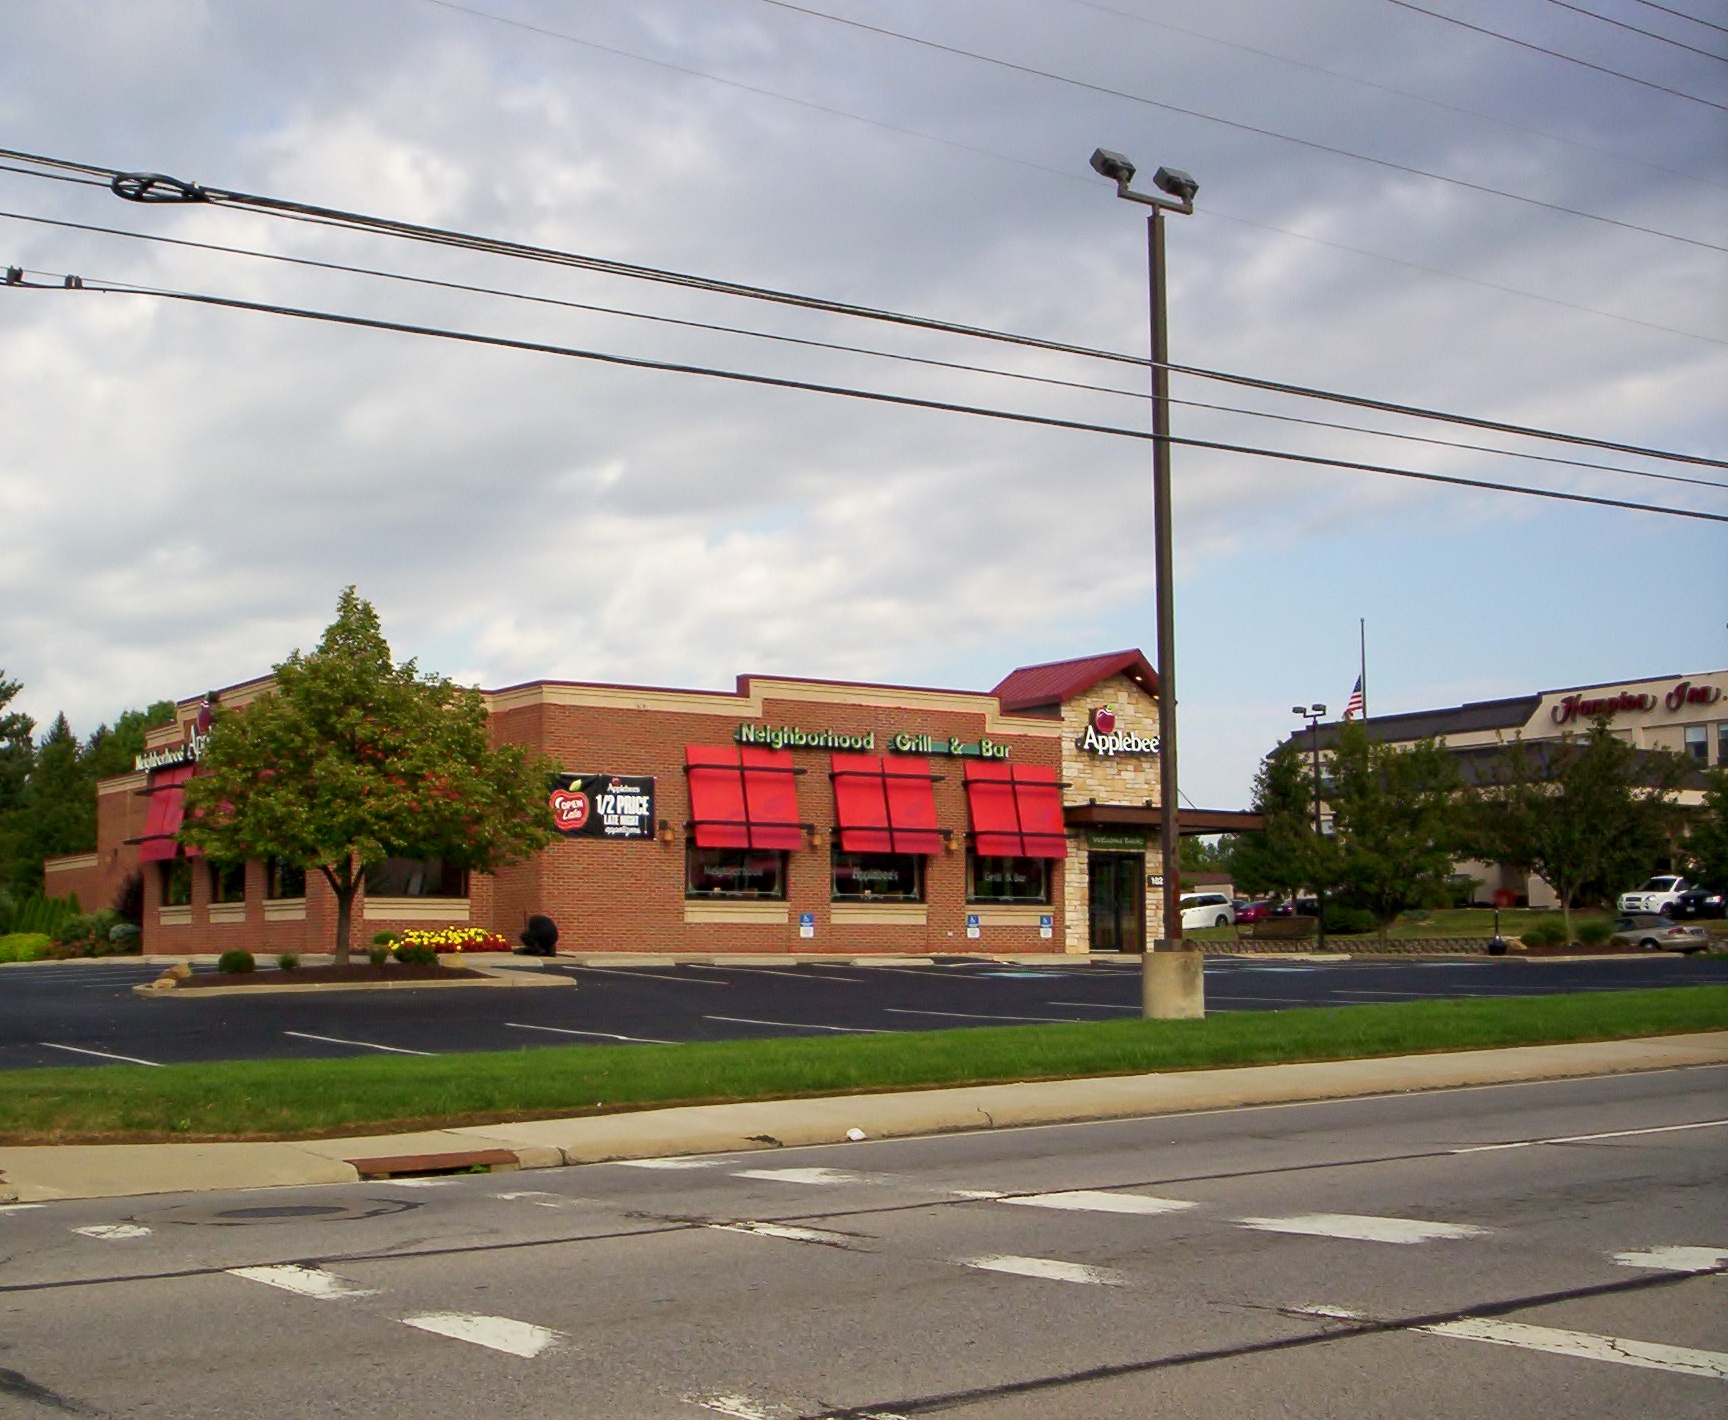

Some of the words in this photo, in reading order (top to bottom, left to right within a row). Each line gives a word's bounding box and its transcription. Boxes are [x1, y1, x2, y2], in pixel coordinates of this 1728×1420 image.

[1551, 691, 1658, 724] Hampton
[1665, 681, 1721, 712] Inn
[739, 723, 875, 748] Neighborhood
[894, 733, 932, 752] Grill
[949, 736, 964, 755] &
[980, 739, 1012, 758] Bar
[1083, 724, 1160, 756] Applebee'
[560, 799, 584, 811] OPEN
[596, 794, 616, 815] 1/2
[616, 795, 650, 816] PRICE
